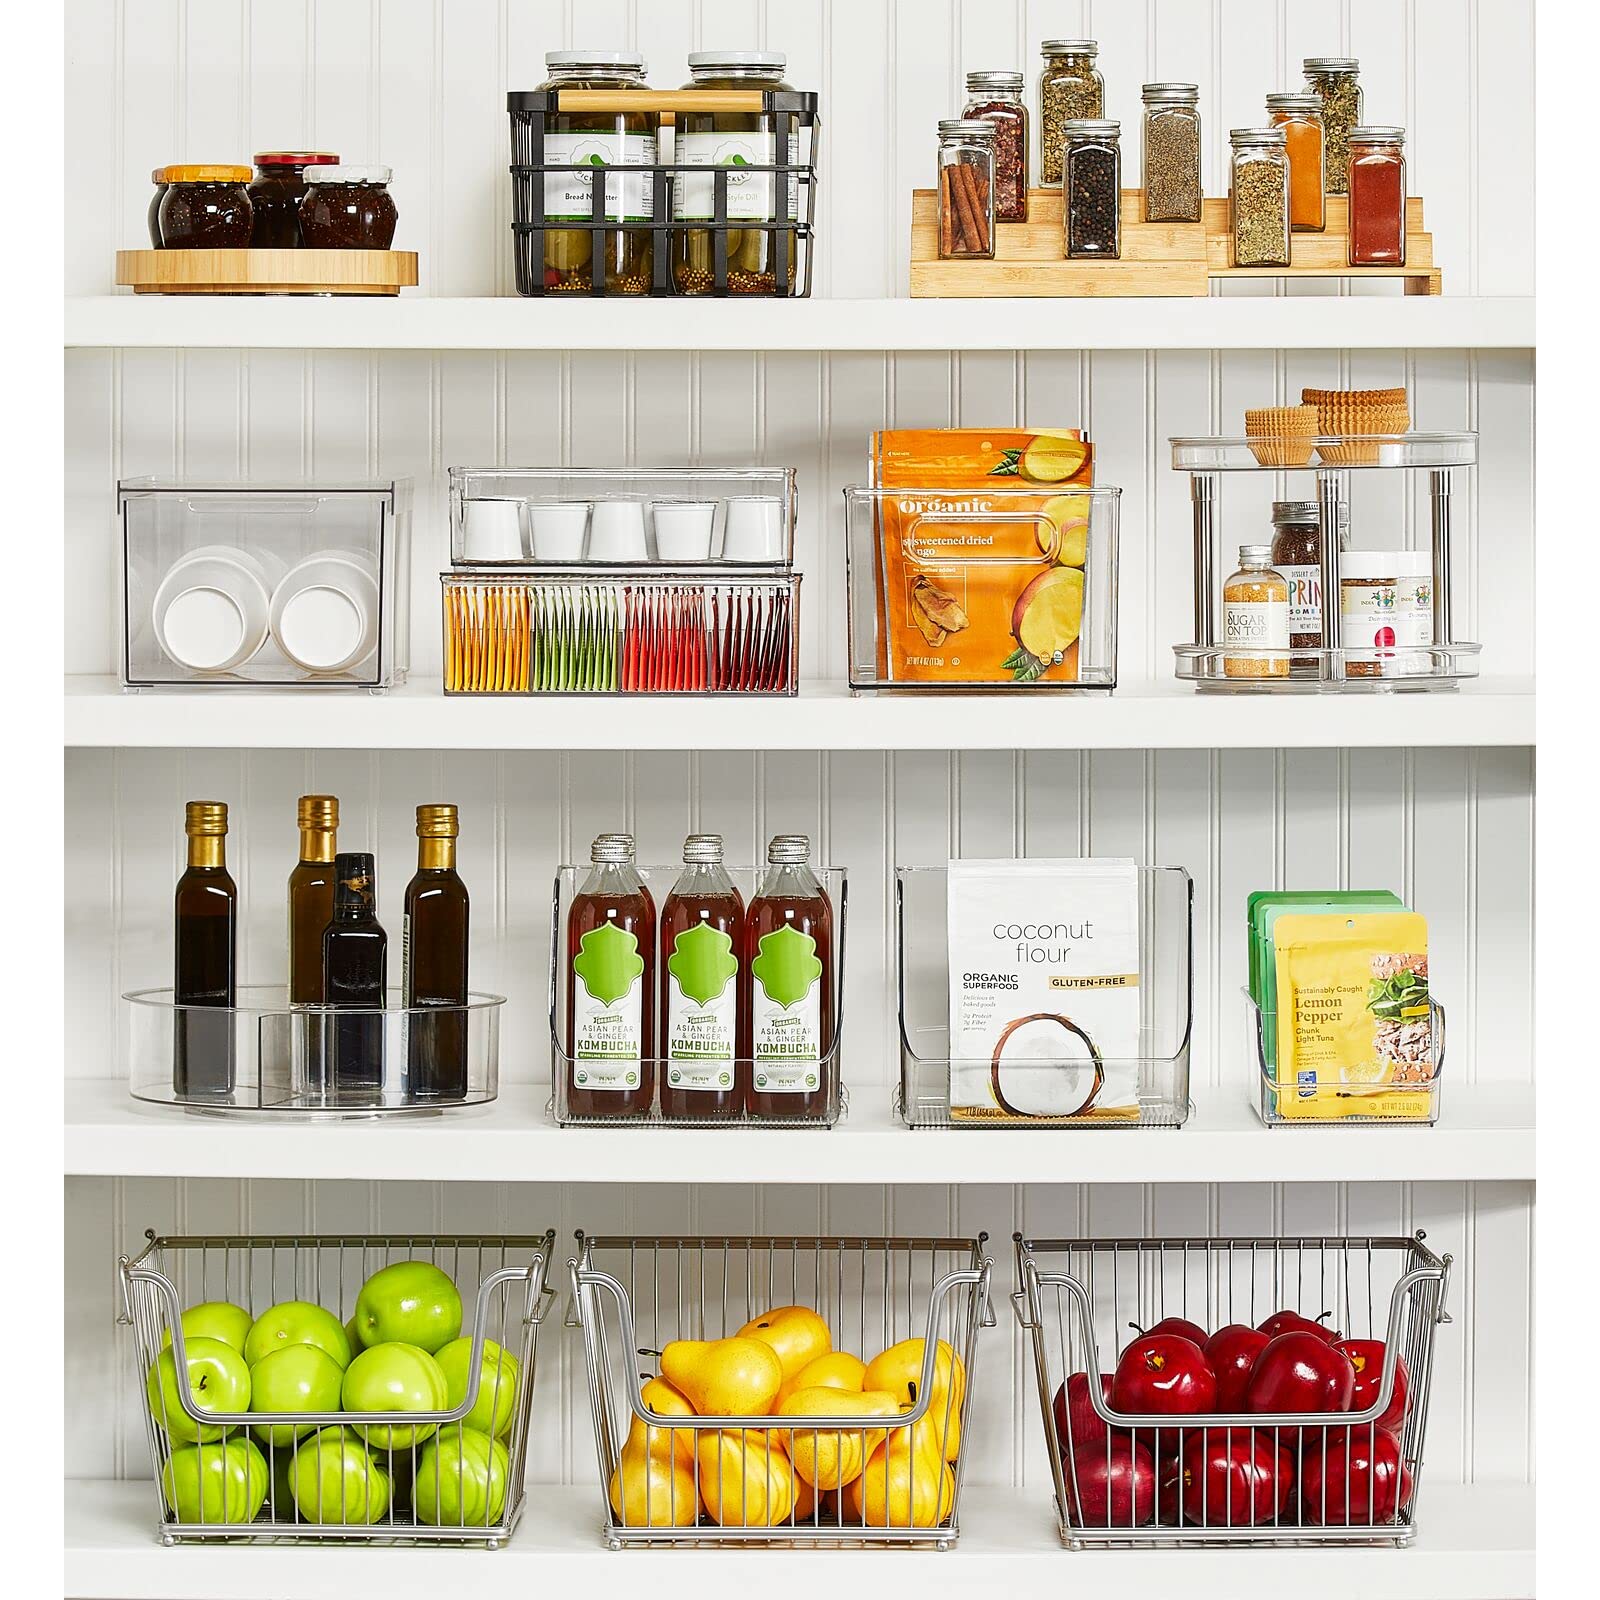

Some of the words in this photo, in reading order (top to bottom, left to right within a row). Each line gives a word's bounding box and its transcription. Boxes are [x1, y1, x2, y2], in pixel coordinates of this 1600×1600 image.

[565, 193, 584, 201] Bread
[900, 497, 993, 514] organic
[967, 536, 993, 545] dried
[1227, 610, 1266, 626] SUGAR
[1227, 626, 1241, 635] ON
[1243, 626, 1267, 635] TOP
[993, 920, 1094, 940] coconut
[1016, 942, 1071, 963] flour
[963, 972, 1019, 983] ORGANIC
[1052, 977, 1126, 987] GLUTEN-FREE
[963, 982, 1019, 990] SUPERFOOD
[1294, 986, 1335, 995] Sustainably
[1336, 985, 1363, 994] Caught
[1295, 998, 1343, 1009] Lemon
[1295, 1011, 1344, 1025] Pepper
[676, 1024, 702, 1032] ASIAN
[1295, 1027, 1320, 1035] Chunk
[1296, 1035, 1315, 1043] Light
[1316, 1034, 1334, 1042] Tuna
[577, 1040, 637, 1051] KOMBUCHA
[671, 1039, 731, 1051] KOMBUCHA
[756, 1043, 817, 1053] KOMBUCHA
